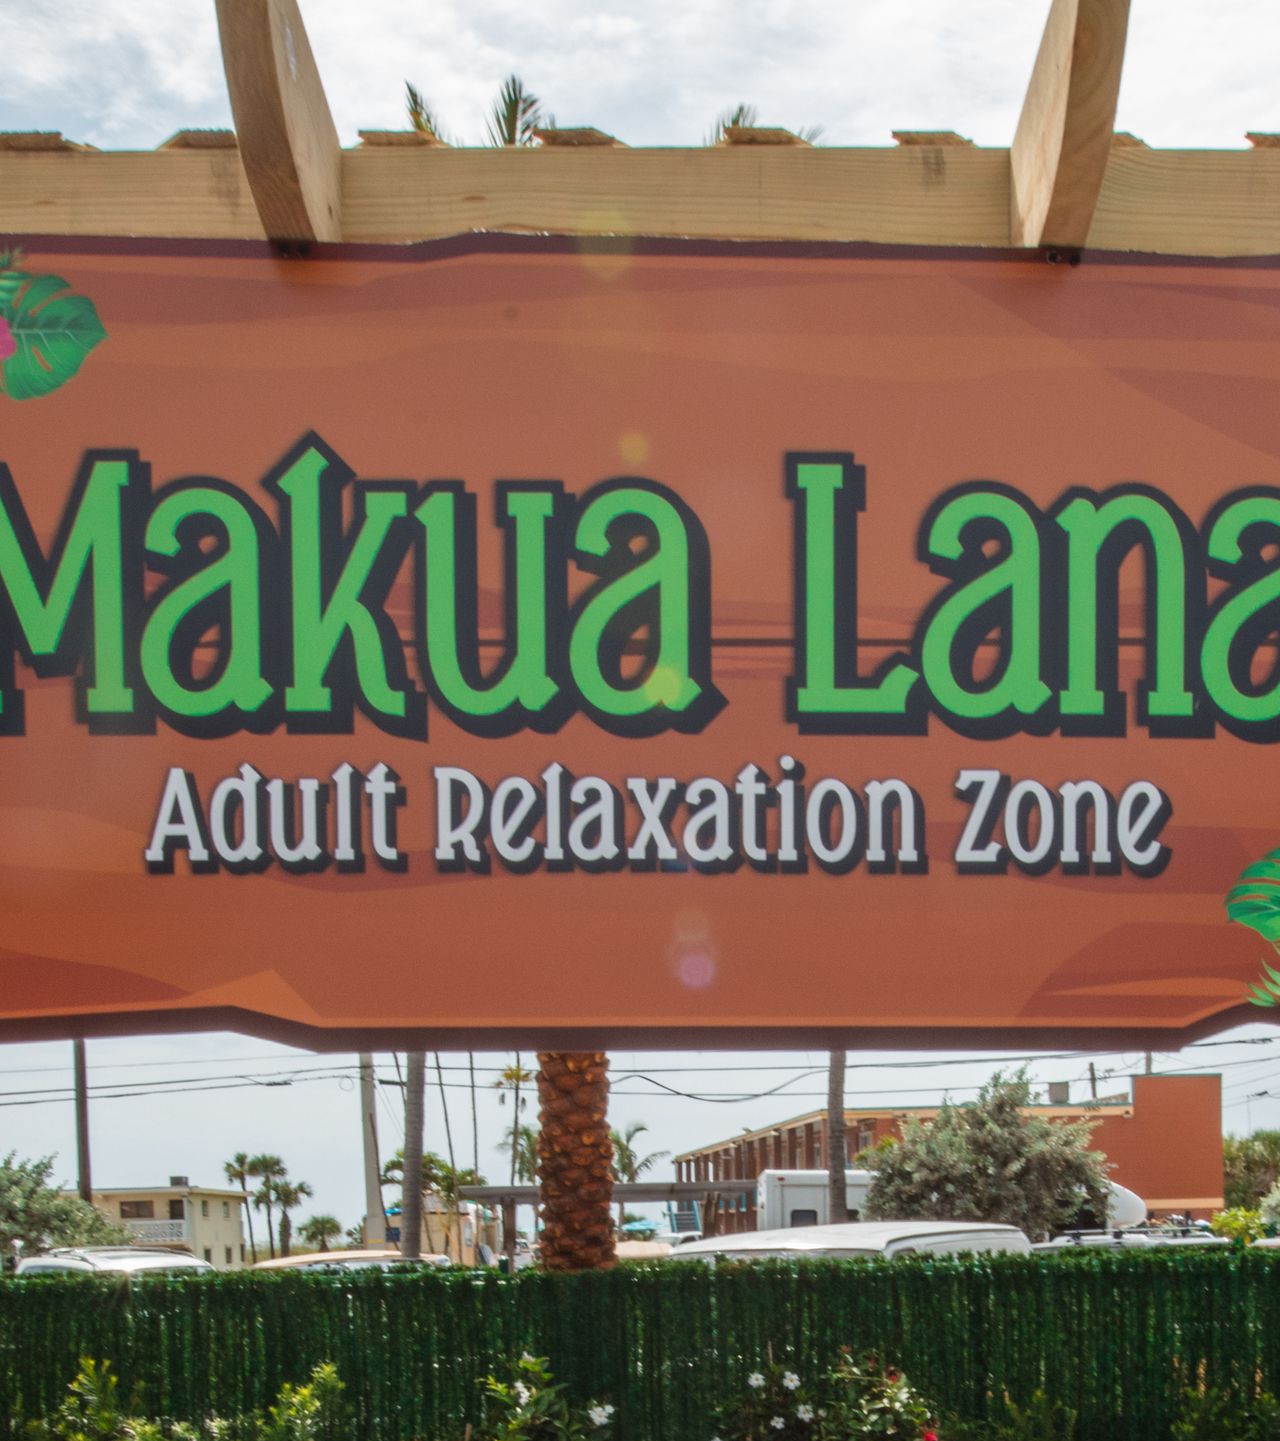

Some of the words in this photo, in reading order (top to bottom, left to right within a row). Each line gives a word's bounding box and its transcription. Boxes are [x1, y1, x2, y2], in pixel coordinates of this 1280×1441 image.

[144, 760, 407, 872] Adult
[433, 754, 927, 873] Relaxation
[954, 769, 1171, 875] Zone
